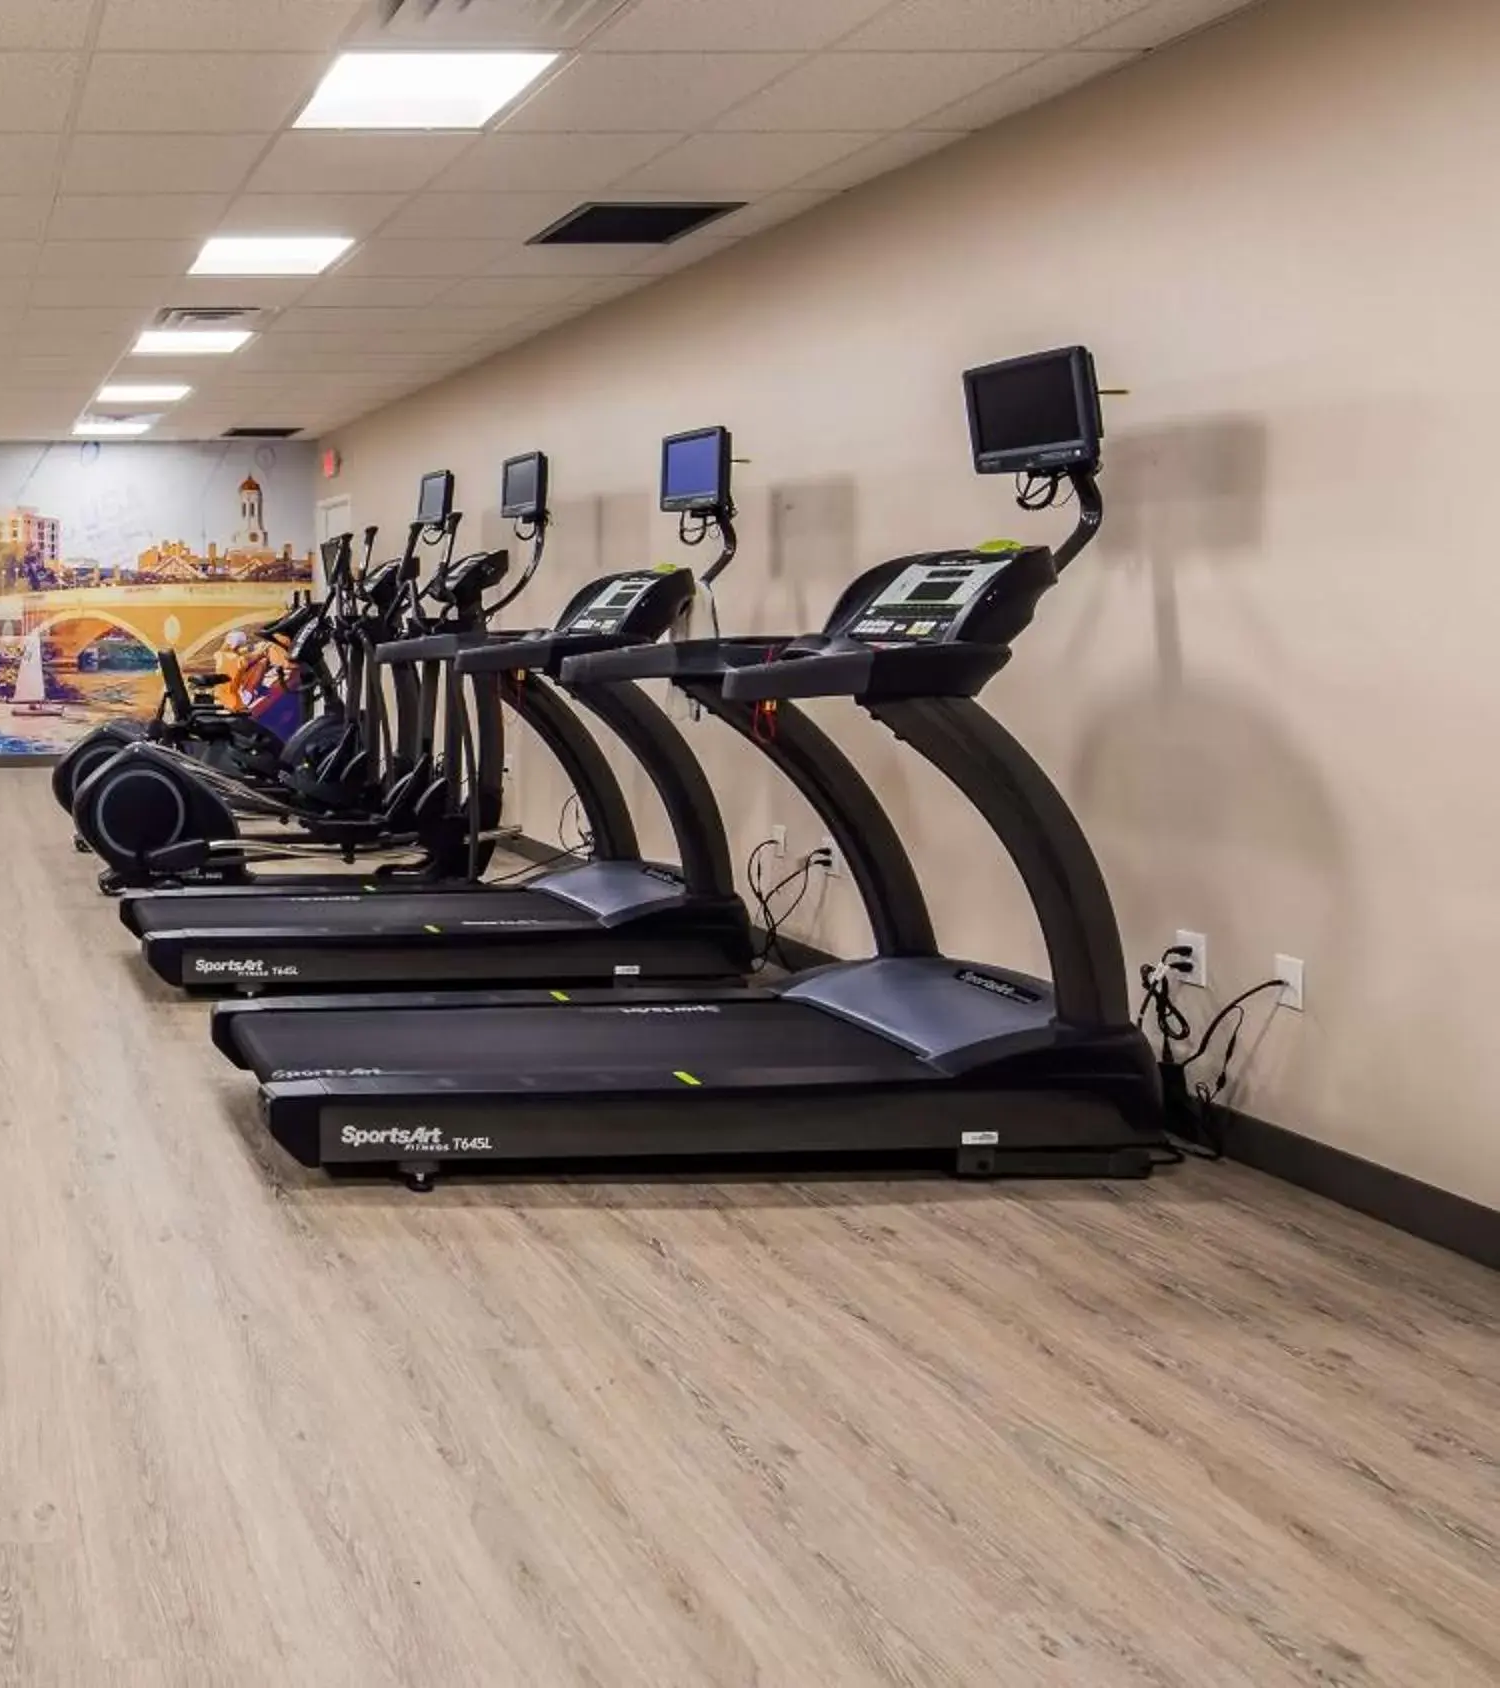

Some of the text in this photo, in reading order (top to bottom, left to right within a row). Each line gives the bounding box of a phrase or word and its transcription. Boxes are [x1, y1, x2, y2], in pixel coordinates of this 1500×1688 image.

[195, 959, 265, 974] SportsArt
[341, 1125, 442, 1147] SportsArt
[452, 1136, 493, 1151] T645L
